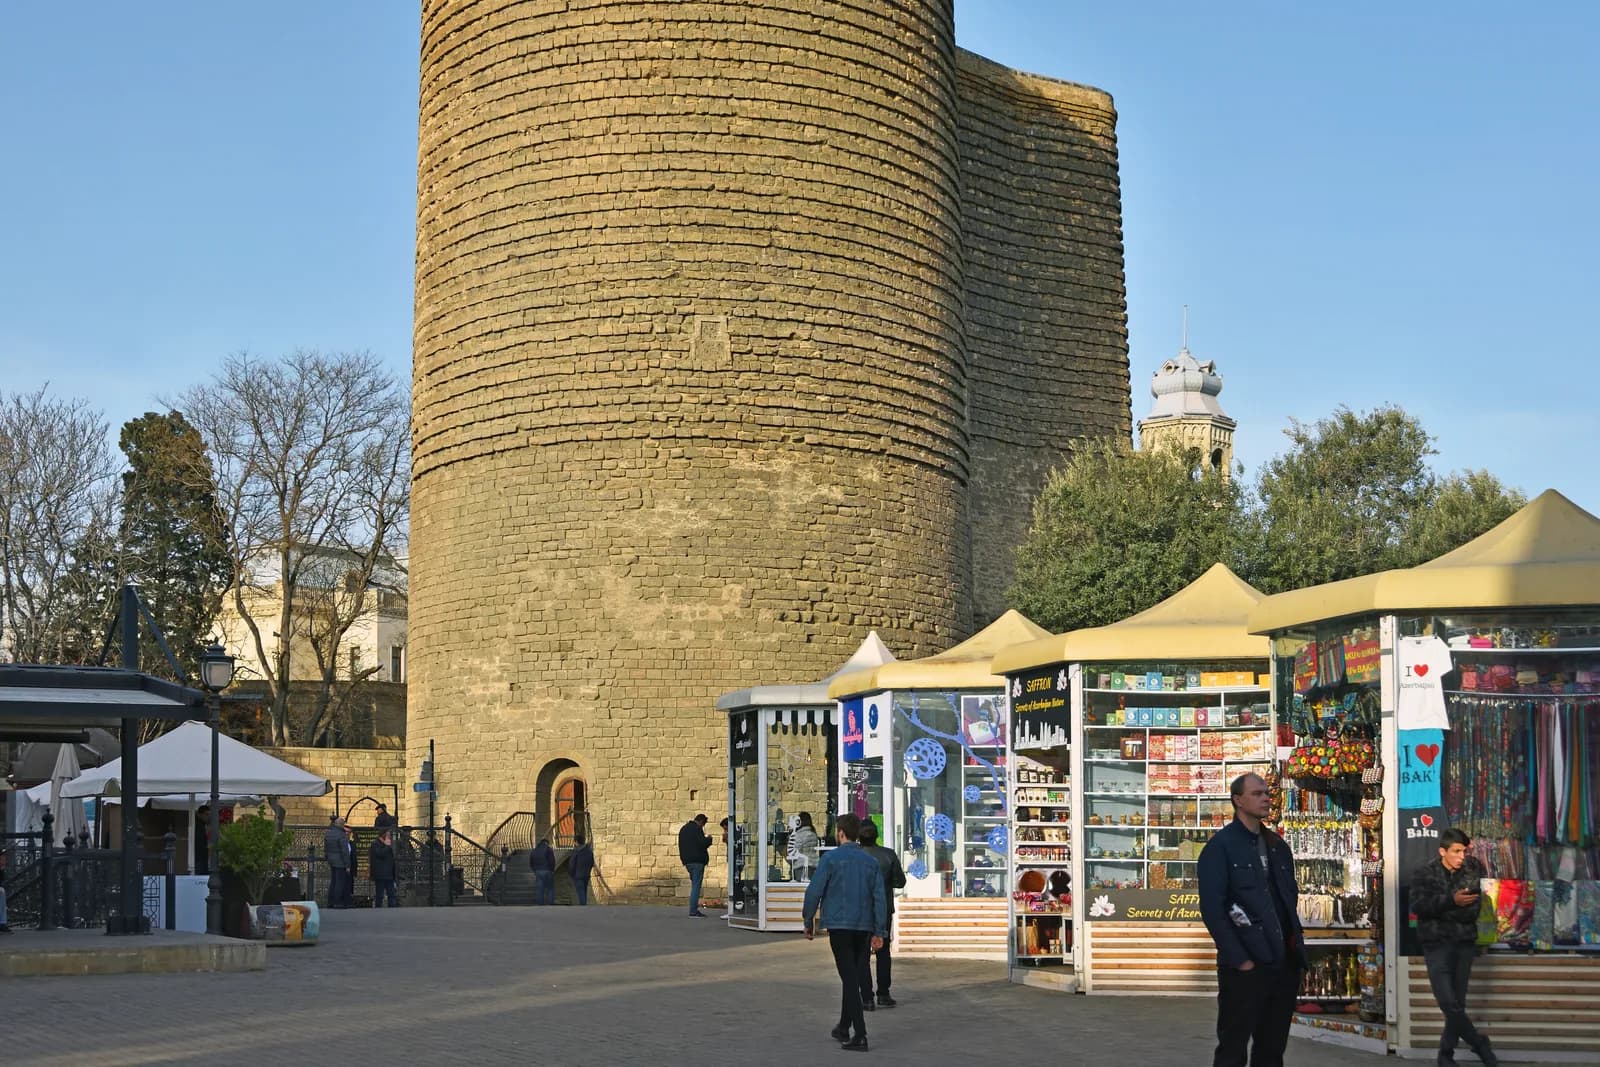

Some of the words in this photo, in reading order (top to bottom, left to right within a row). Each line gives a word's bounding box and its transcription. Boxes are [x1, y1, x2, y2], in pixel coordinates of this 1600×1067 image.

[1405, 665, 1412, 677] I
[1026, 676, 1052, 693] SAFFRON
[1403, 744, 1412, 768] I
[1402, 770, 1436, 783] BAK
[1411, 817, 1418, 827] I
[1406, 827, 1439, 839] Baku
[1126, 907, 1163, 918] Secrets
[1164, 907, 1177, 920] of
